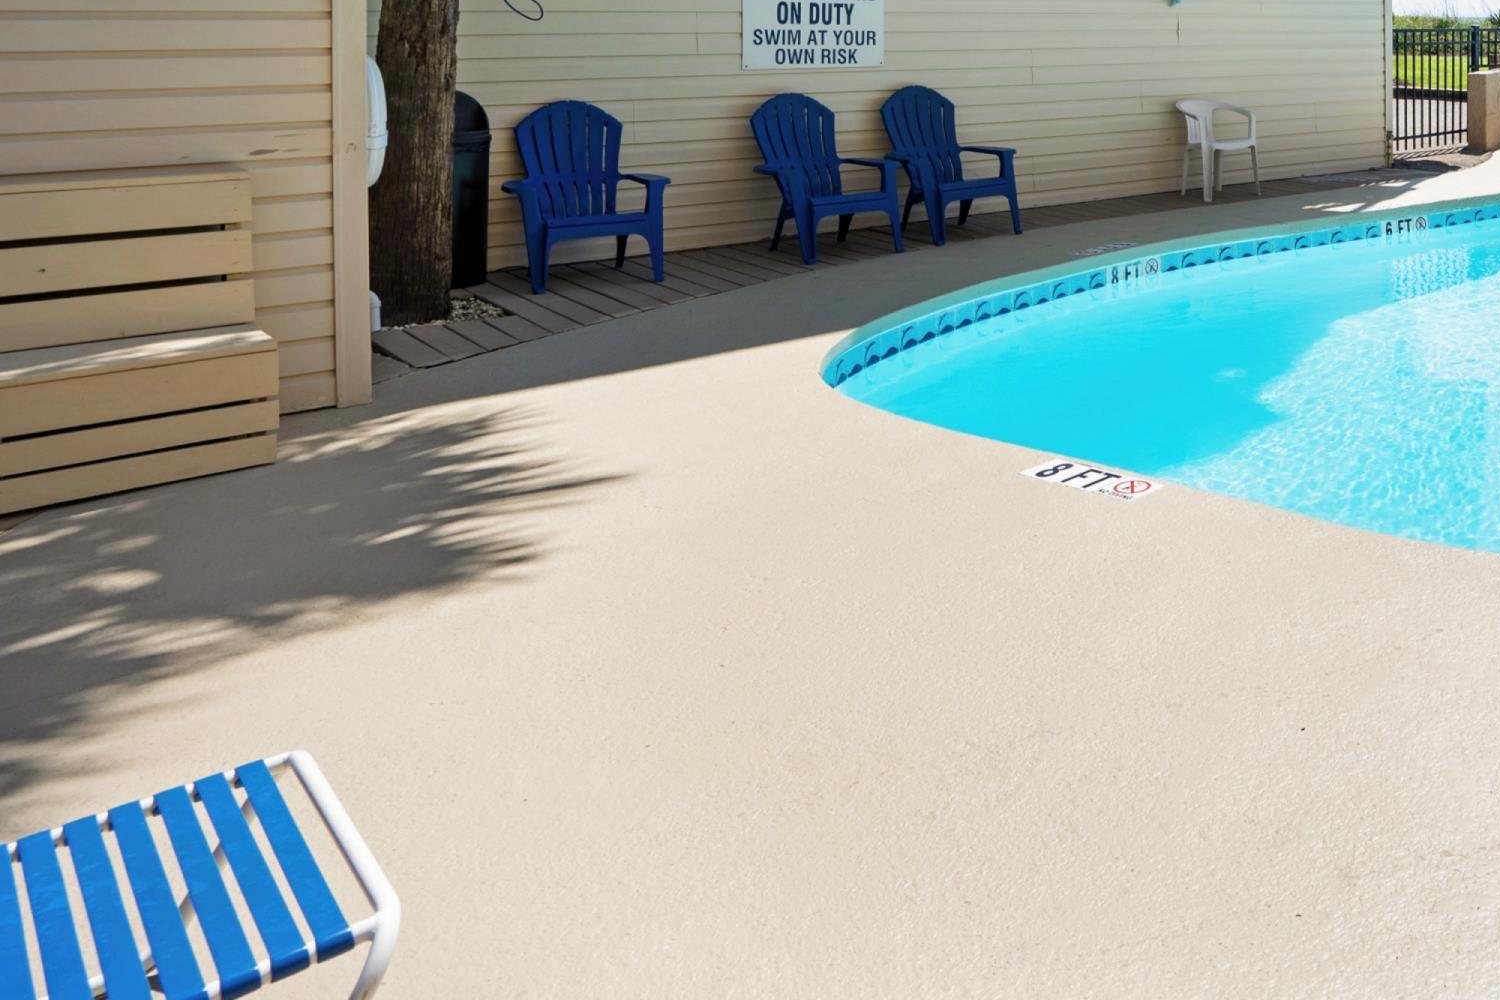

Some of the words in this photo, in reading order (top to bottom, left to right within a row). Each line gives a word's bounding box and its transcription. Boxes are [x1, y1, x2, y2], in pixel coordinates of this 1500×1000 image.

[776, 1, 802, 25] ON
[809, 2, 855, 25] DUTY
[752, 28, 802, 46] SWIM
[807, 30, 828, 46] AT
[833, 30, 877, 46] YOUR
[775, 48, 815, 65] OWN
[821, 49, 858, 65] RISK
[1385, 221, 1393, 236] 6
[1397, 218, 1412, 234] FT
[1111, 265, 1119, 284] 8
[1125, 261, 1142, 281] FT
[1035, 463, 1074, 478] 8
[1060, 468, 1122, 489] FT
